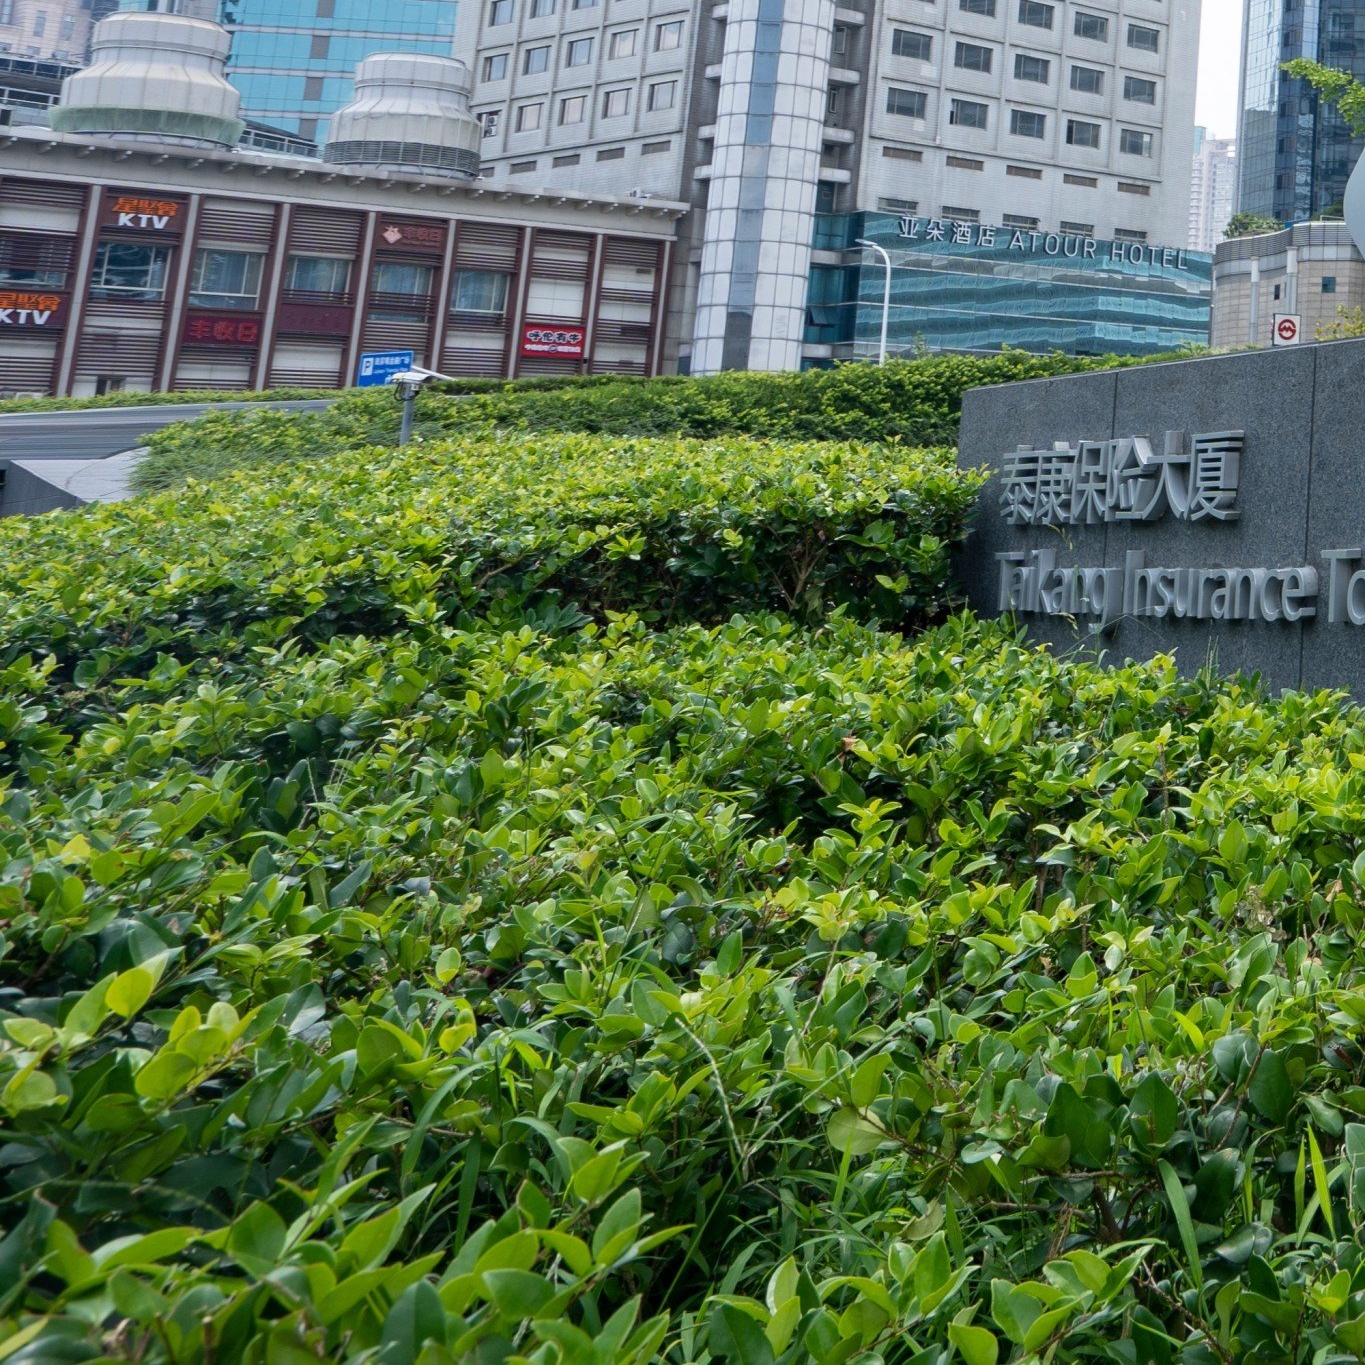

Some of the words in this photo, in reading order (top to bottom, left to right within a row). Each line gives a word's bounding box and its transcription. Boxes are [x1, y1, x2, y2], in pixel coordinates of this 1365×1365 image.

[118, 213, 170, 229] KTV
[900, 215, 997, 247] 亚朵酒店
[1009, 230, 1098, 259] ATOUR
[1109, 241, 1189, 270] HOTEL
[0, 308, 52, 325] KTV
[999, 430, 1245, 525] 泰康保险大厦
[995, 549, 1123, 635] Taikang
[1123, 550, 1318, 622] Insurance
